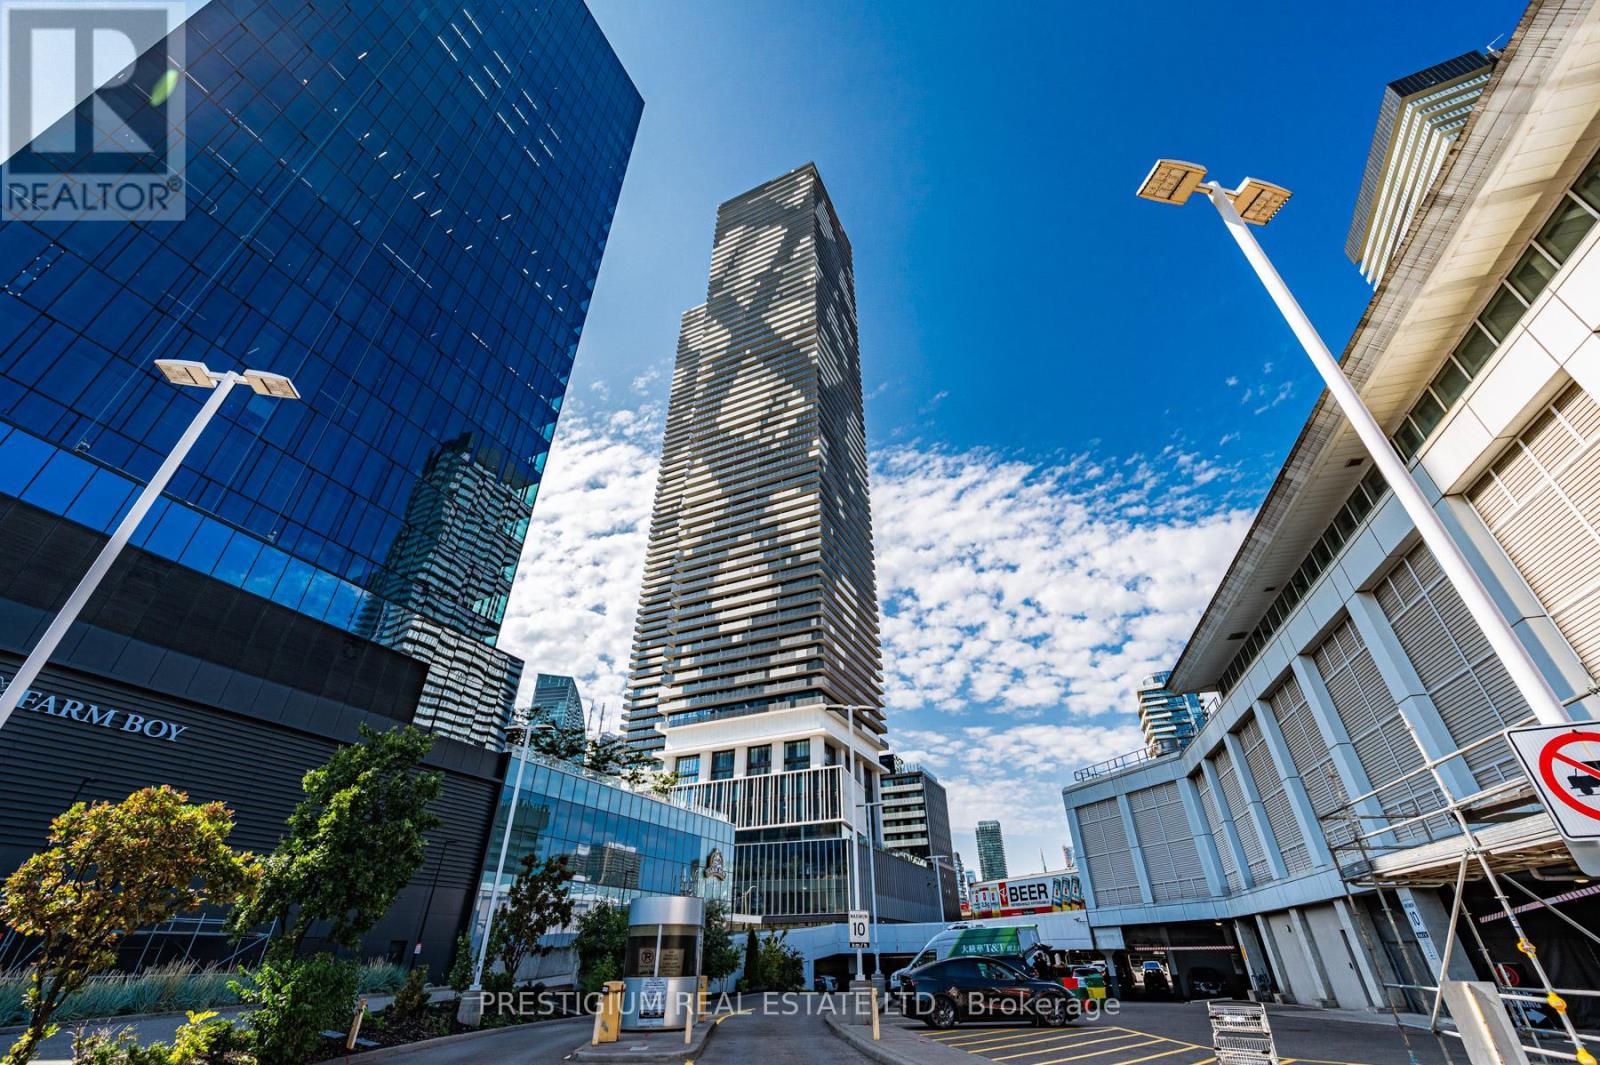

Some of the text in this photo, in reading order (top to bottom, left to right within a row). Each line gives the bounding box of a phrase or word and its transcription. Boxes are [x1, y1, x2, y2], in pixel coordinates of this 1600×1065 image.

[16, 689, 188, 742] FARM BOY
[1009, 883, 1049, 903] BEER
[853, 922, 865, 936] 10
